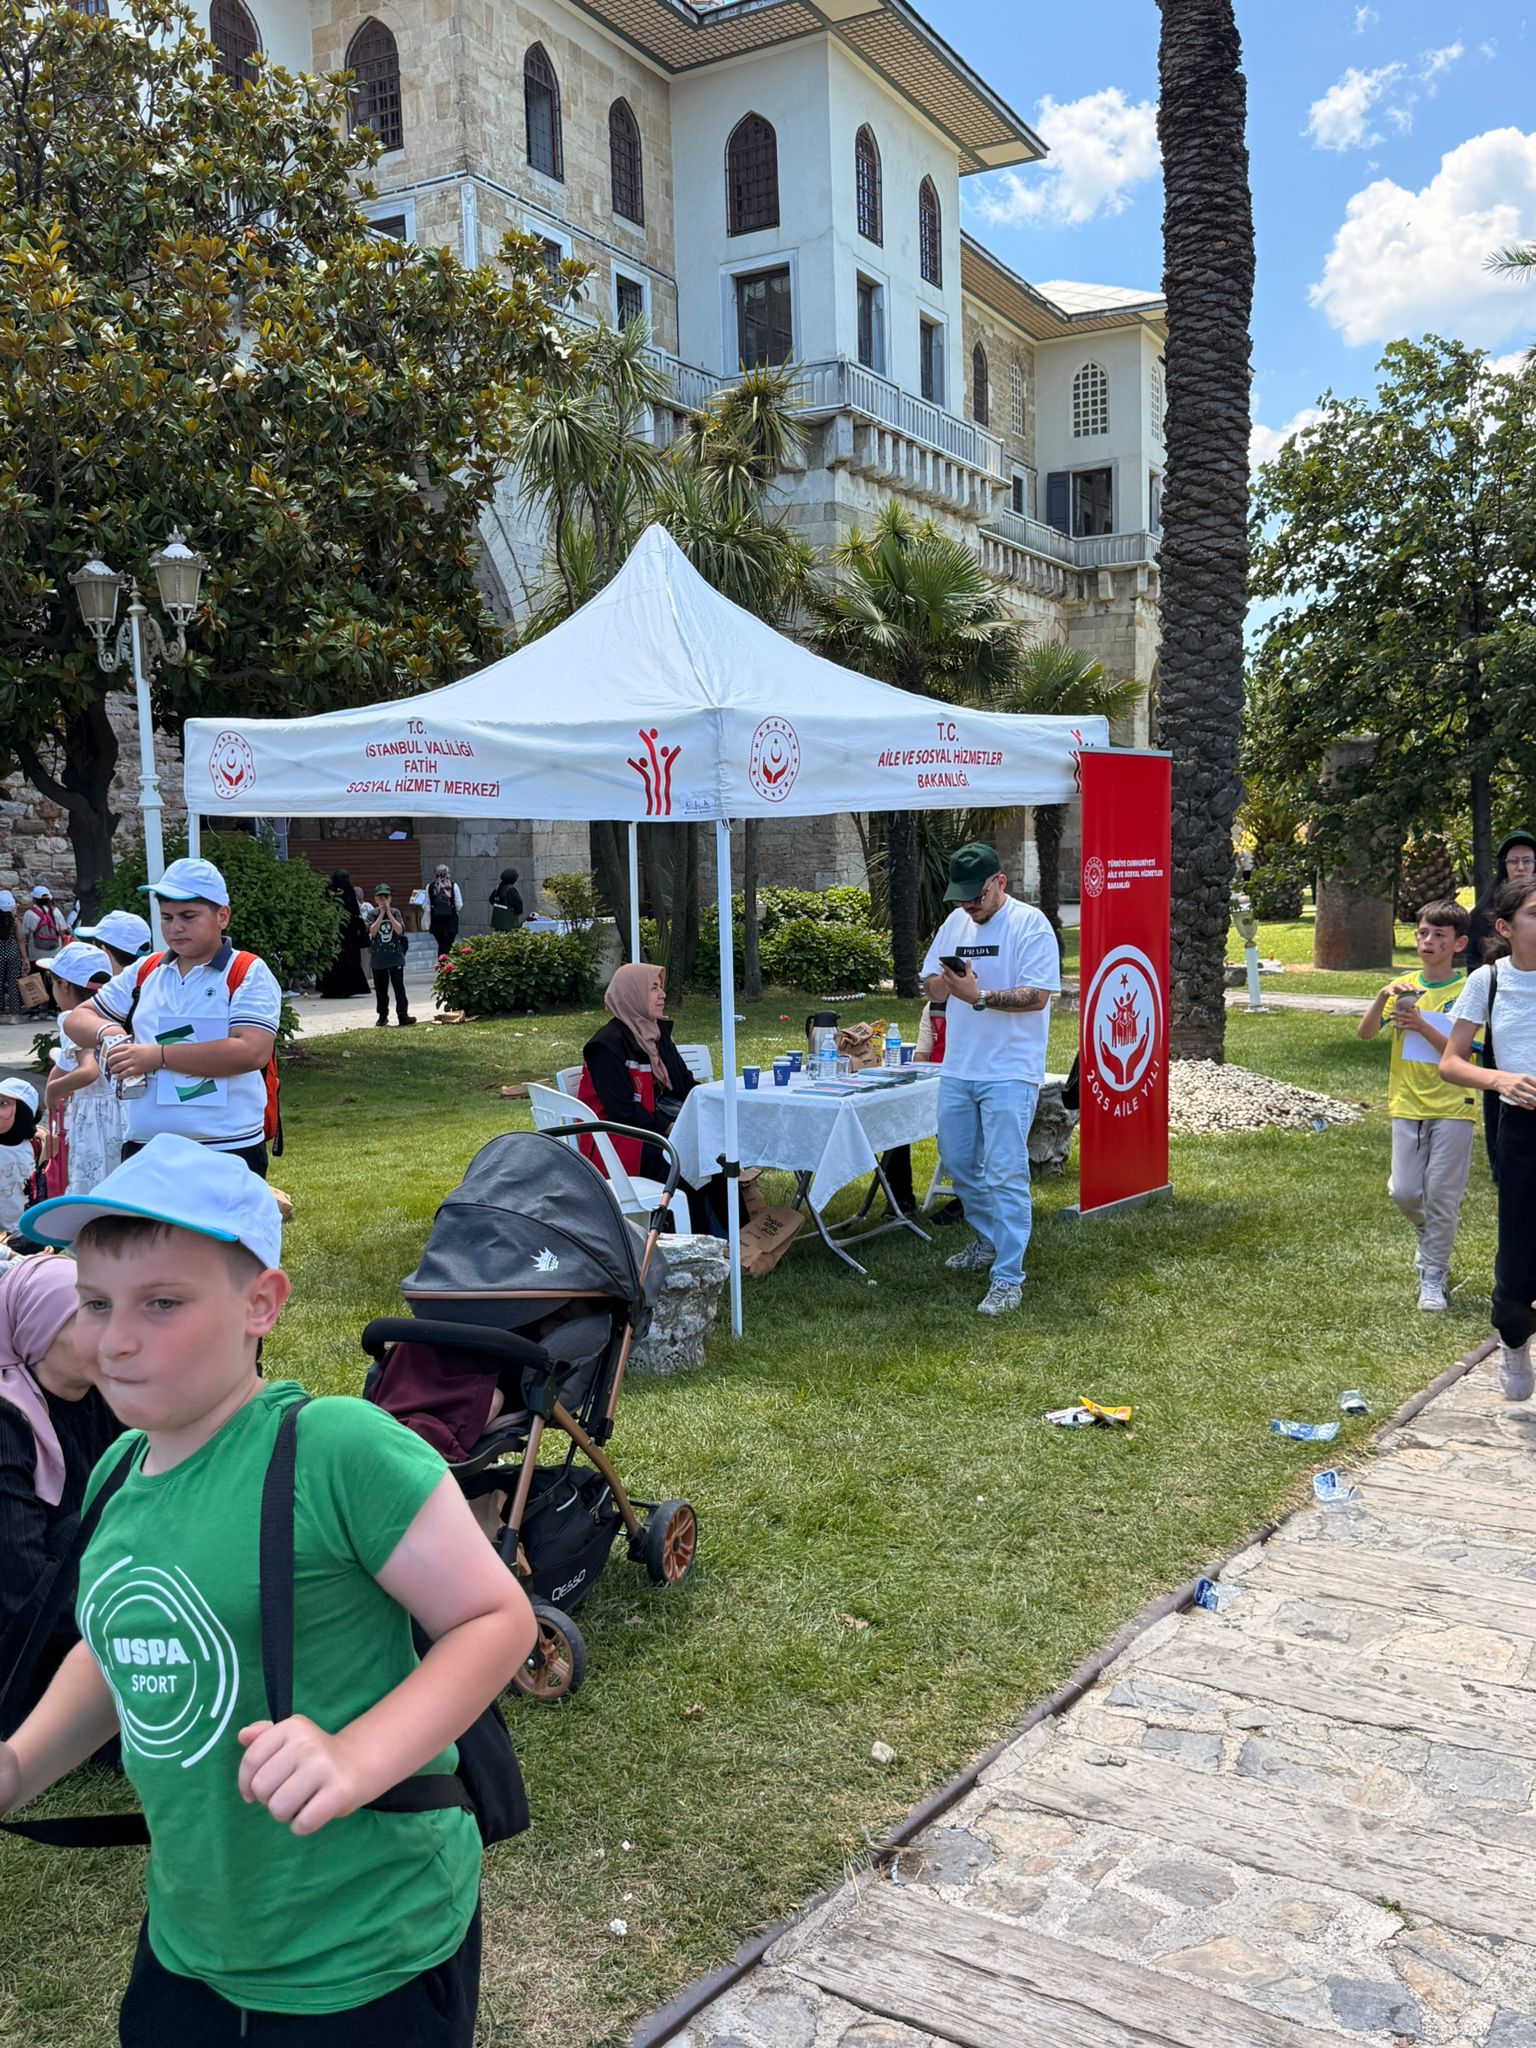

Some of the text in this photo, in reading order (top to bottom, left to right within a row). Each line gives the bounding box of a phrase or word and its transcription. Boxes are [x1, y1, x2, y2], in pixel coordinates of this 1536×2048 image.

[407, 721, 427, 735] T.C.
[937, 722, 959, 742] T.C.
[365, 739, 475, 758] İSTANBUL VALİLİĞİ
[878, 746, 1003, 767] AİLE VE SOSYAL HİZMETLER
[404, 756, 437, 774] FATİH
[346, 776, 500, 798] SOSYAL HİZMET MERKEZİ
[917, 770, 970, 789] BAKANLIĞI
[1086, 1060, 1160, 1118] 2025 AİLE YILI
[112, 1637, 190, 1665] USPA
[131, 1674, 177, 1694] SPORT
